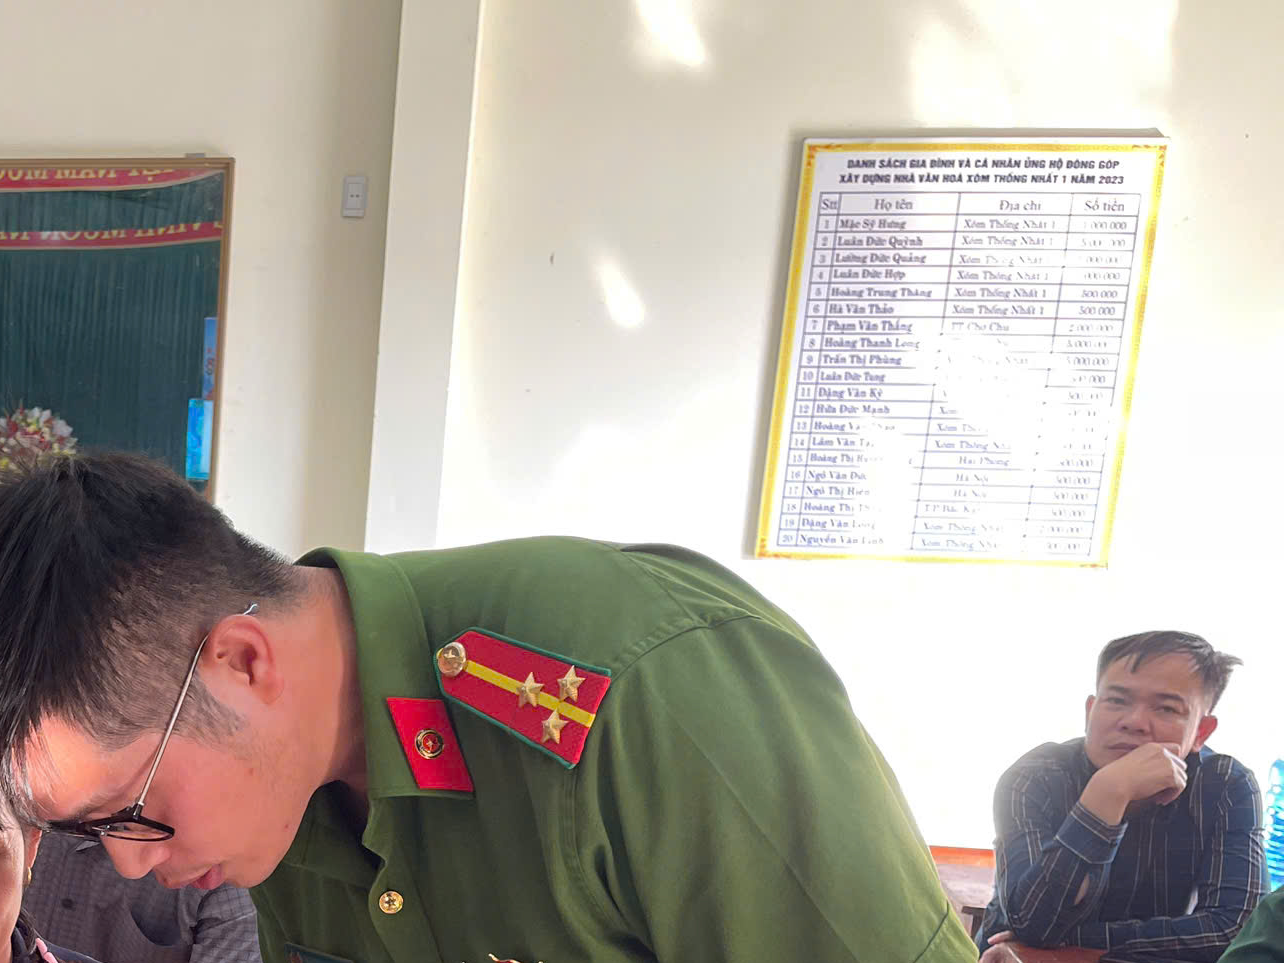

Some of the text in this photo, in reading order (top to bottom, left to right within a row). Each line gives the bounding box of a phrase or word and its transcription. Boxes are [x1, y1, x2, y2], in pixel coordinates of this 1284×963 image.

[847, 156, 1120, 171] DANH SÁCH GIA ĐÌNH VÀ CÁ NHÂN ỦNG HỘ ĐÓNG GÓP
[839, 172, 860, 184] XÂY
[862, 173, 891, 186] DỰNG
[893, 173, 915, 184] NHÀ
[918, 173, 940, 184] VĂN
[966, 173, 990, 184] XÓM
[994, 171, 1028, 184] THỐNG
[1030, 171, 1059, 184] NHẤT
[1062, 175, 1067, 184] 1
[1070, 173, 1096, 184] NĂM
[1098, 175, 1125, 185] 2023
[821, 199, 837, 211] Stt
[874, 198, 913, 212] Họ tên
[999, 199, 1020, 212] Địa
[1084, 197, 1125, 212] Số tiền
[878, 219, 907, 230] Hưng
[963, 219, 986, 229] Xóm
[989, 219, 1019, 231] Thống
[821, 236, 828, 247] 2
[888, 234, 924, 249] Quỳnh
[987, 235, 1017, 247] Thống
[819, 254, 826, 264] 3
[884, 268, 906, 281] Hợp
[982, 270, 1012, 282] Thống
[866, 287, 898, 298] Trung
[954, 287, 977, 298] Xóm
[980, 287, 1011, 299] Thống
[1013, 287, 1038, 298] Nhất
[813, 303, 820, 314] 6
[829, 303, 844, 314] Hà
[846, 303, 866, 314] Văn
[952, 304, 975, 314] Xóm
[978, 304, 1009, 316] Thống
[1011, 304, 1036, 315] Nhất
[827, 320, 856, 334] Phạm
[858, 320, 879, 331] Văn
[860, 337, 893, 348] Thanh
[806, 355, 814, 365] 9
[849, 354, 866, 366] Thị
[802, 371, 814, 382] 10
[800, 387, 812, 398] 11
[847, 387, 867, 398] Văn
[798, 404, 810, 414] 12
[796, 421, 808, 431] 13
[794, 437, 805, 447] 14
[836, 437, 856, 447] Văn
[792, 453, 803, 464] 15
[790, 470, 802, 479] 16
[828, 470, 848, 480] Văn
[788, 485, 799, 496] 17
[786, 503, 797, 512] 18
[784, 518, 795, 528] 19
[782, 534, 794, 544] 20
[800, 533, 837, 547] Nguyễn
